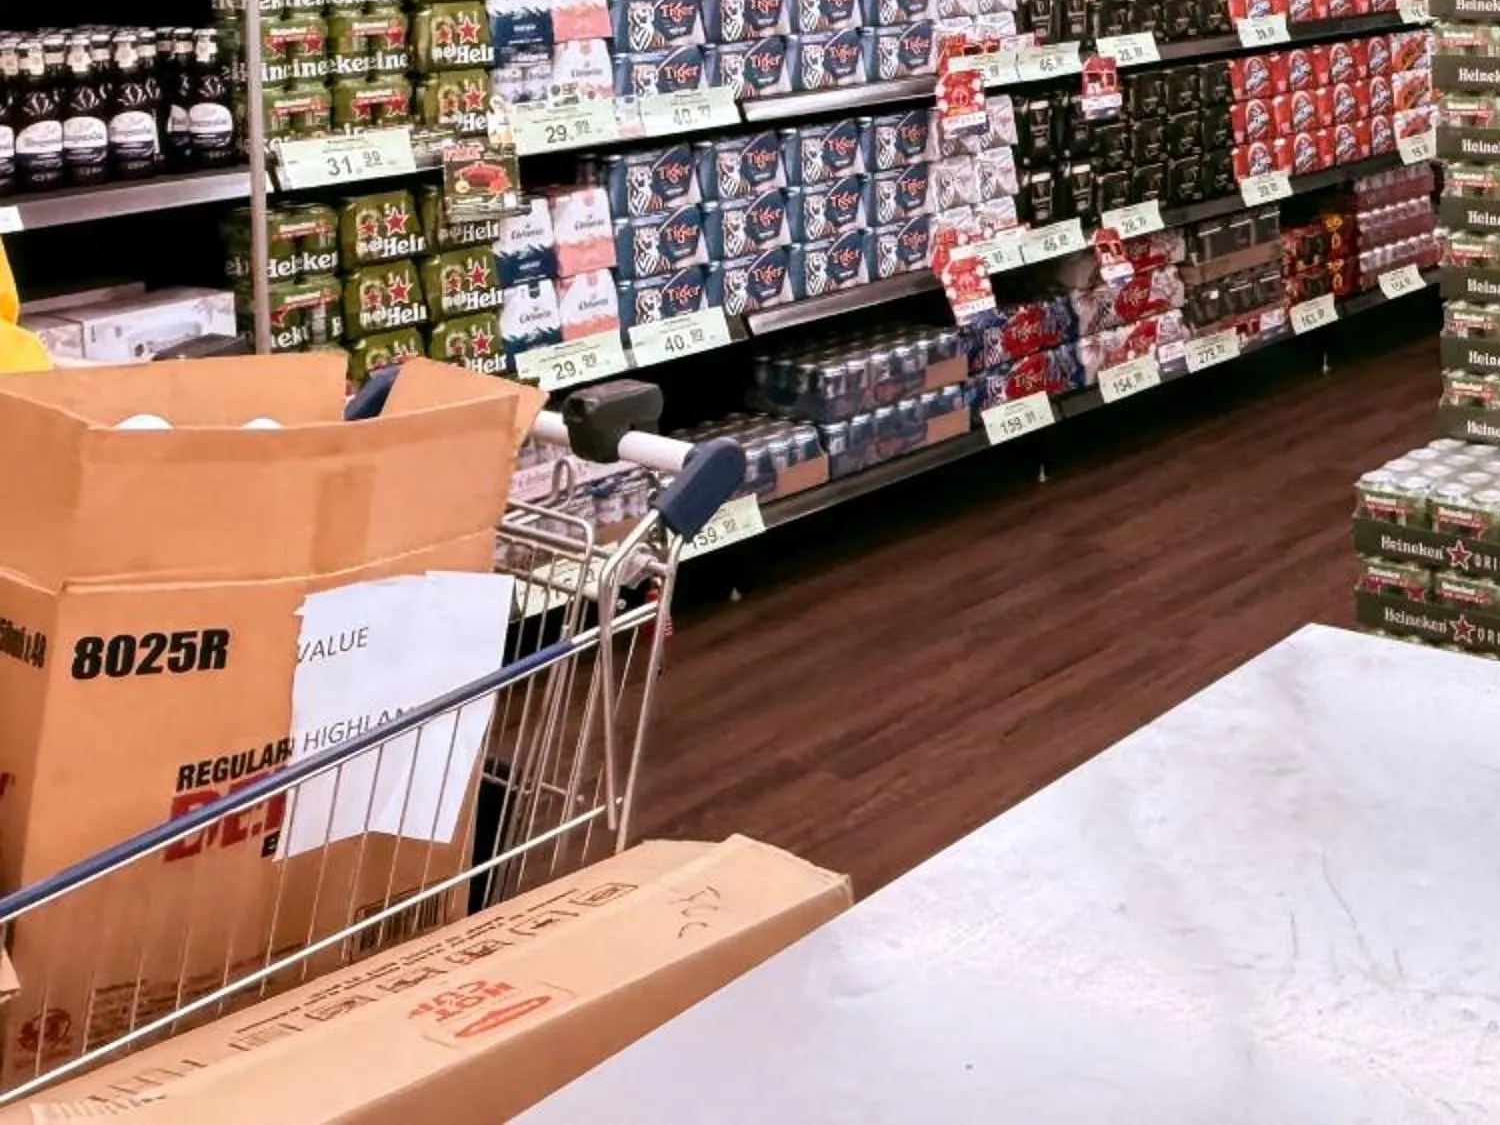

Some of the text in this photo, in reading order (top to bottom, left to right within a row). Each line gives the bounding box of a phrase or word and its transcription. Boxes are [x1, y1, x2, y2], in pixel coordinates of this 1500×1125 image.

[1381, 535, 1444, 559] Heineken
[1384, 607, 1447, 631] Heineken
[70, 628, 230, 681] 8025R
[176, 736, 293, 792] REGULAR
